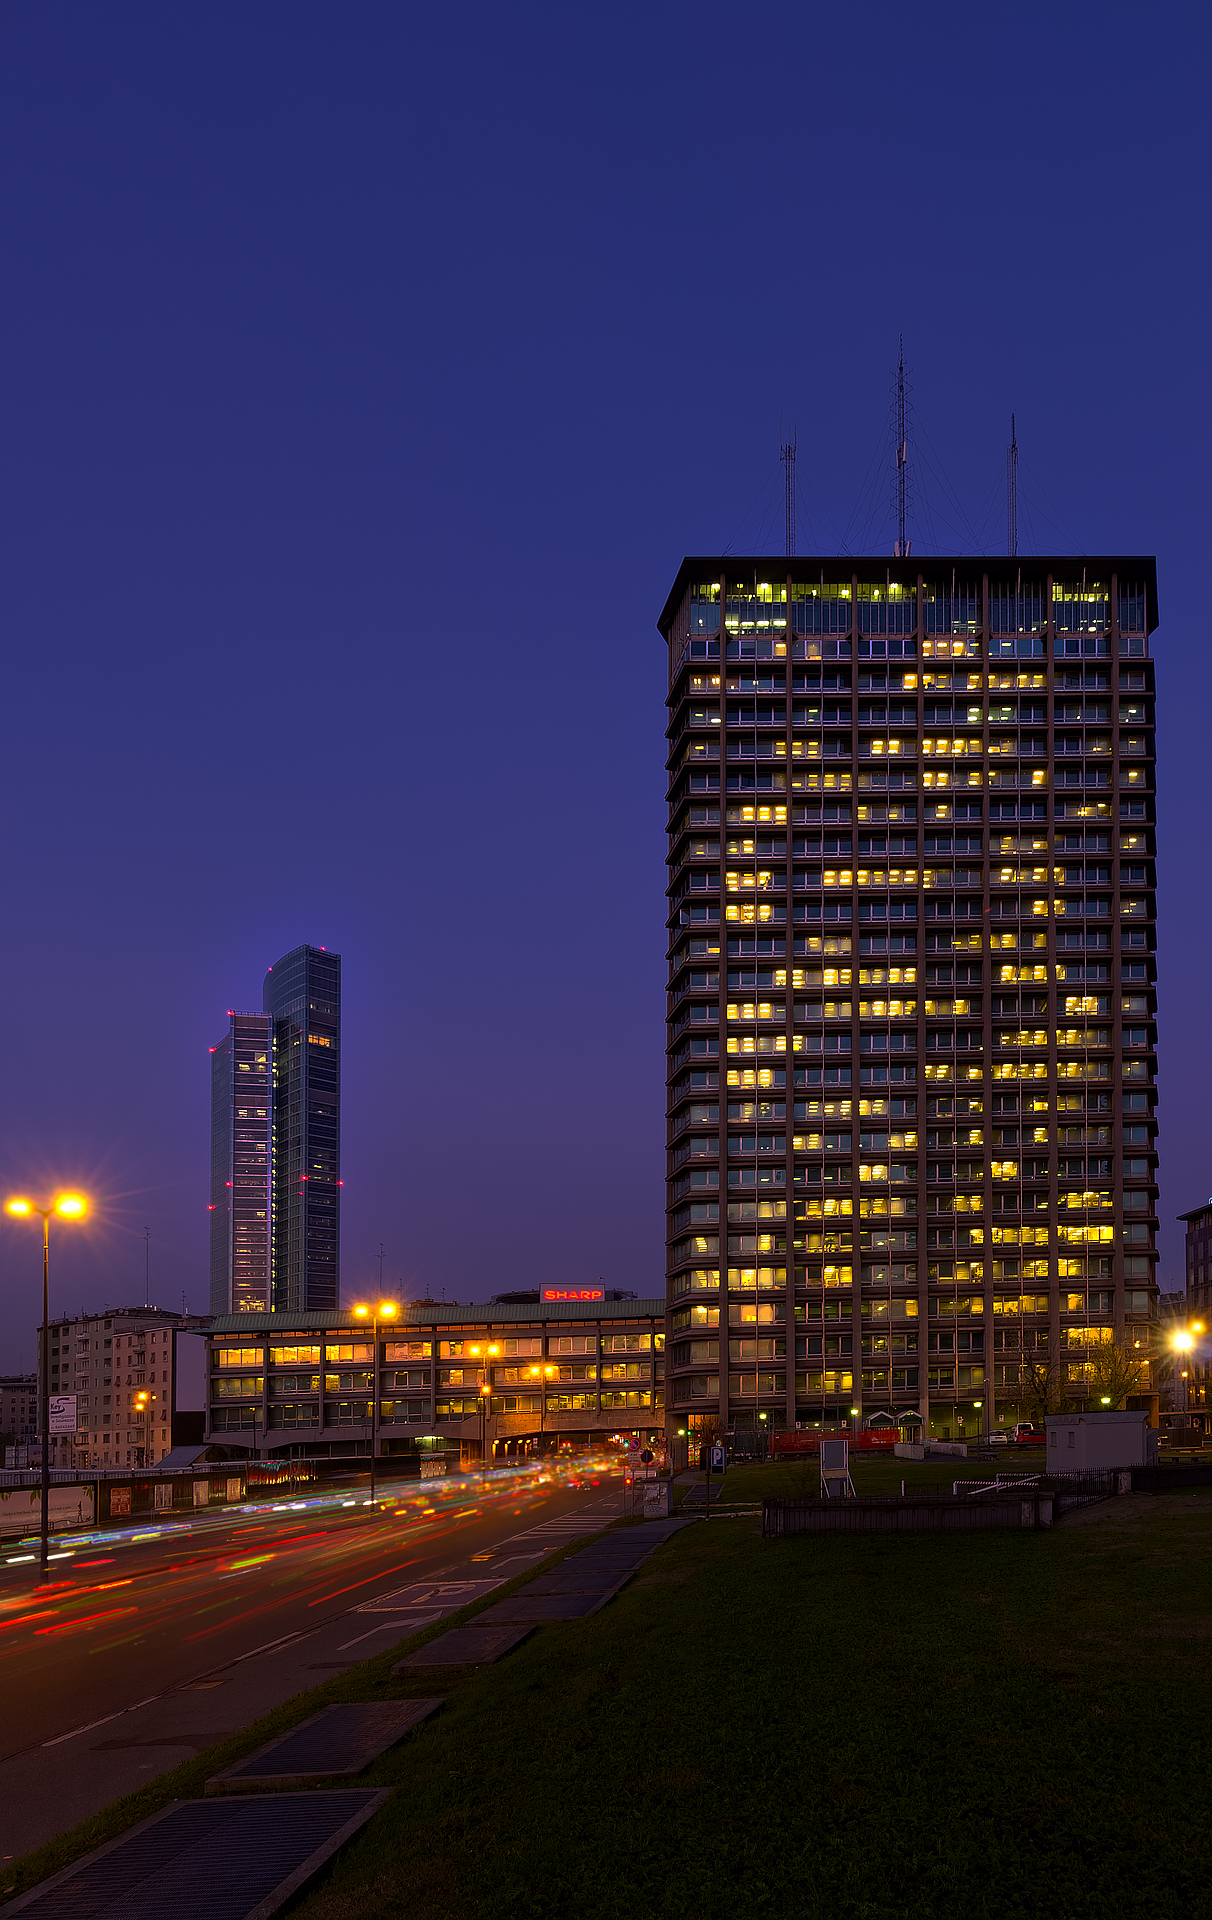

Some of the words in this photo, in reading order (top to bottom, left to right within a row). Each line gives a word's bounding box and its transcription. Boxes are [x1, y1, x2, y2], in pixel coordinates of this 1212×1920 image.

[543, 1289, 603, 1301] SHARP
[713, 1449, 722, 1465] P
[410, 1584, 477, 1604] P
